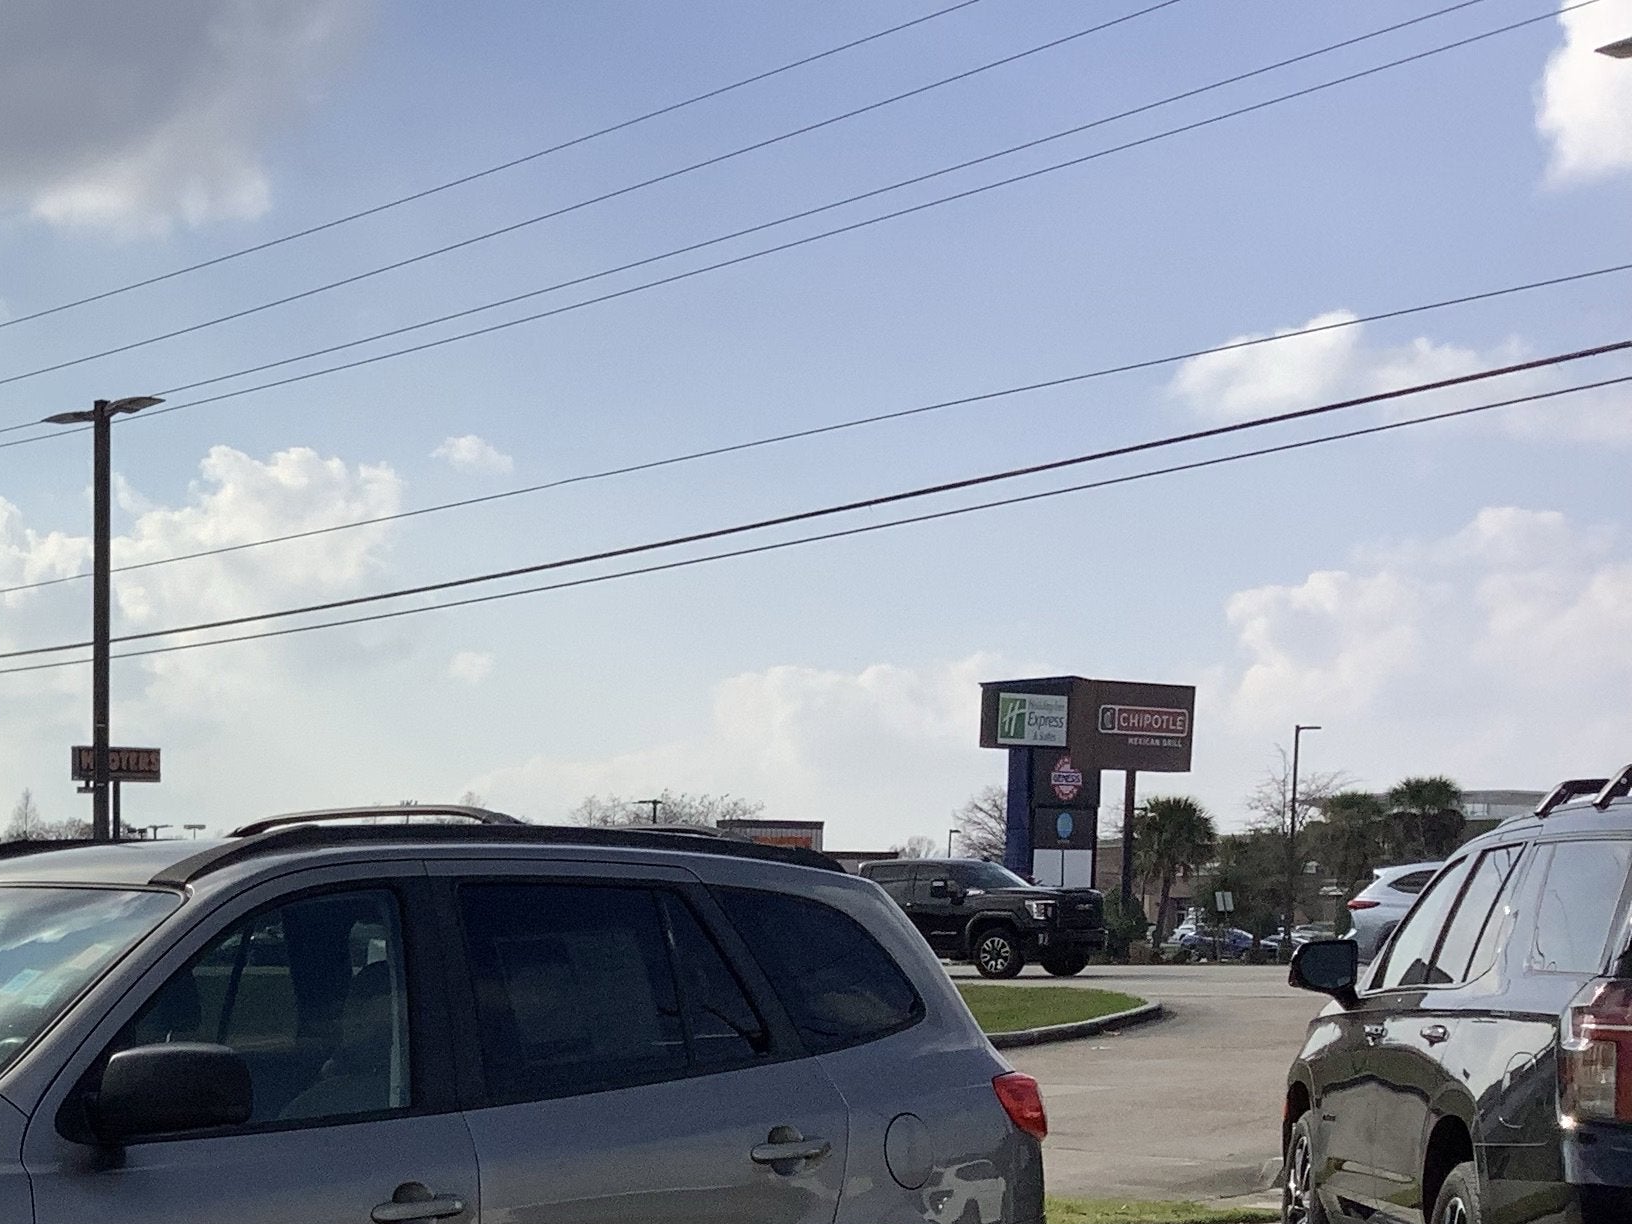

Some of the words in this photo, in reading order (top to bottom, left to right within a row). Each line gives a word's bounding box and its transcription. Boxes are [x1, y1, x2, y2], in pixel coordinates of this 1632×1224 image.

[1028, 711, 1064, 730] Express
[1120, 713, 1184, 730] CHIPOTLE
[80, 749, 160, 772] HOTERS
